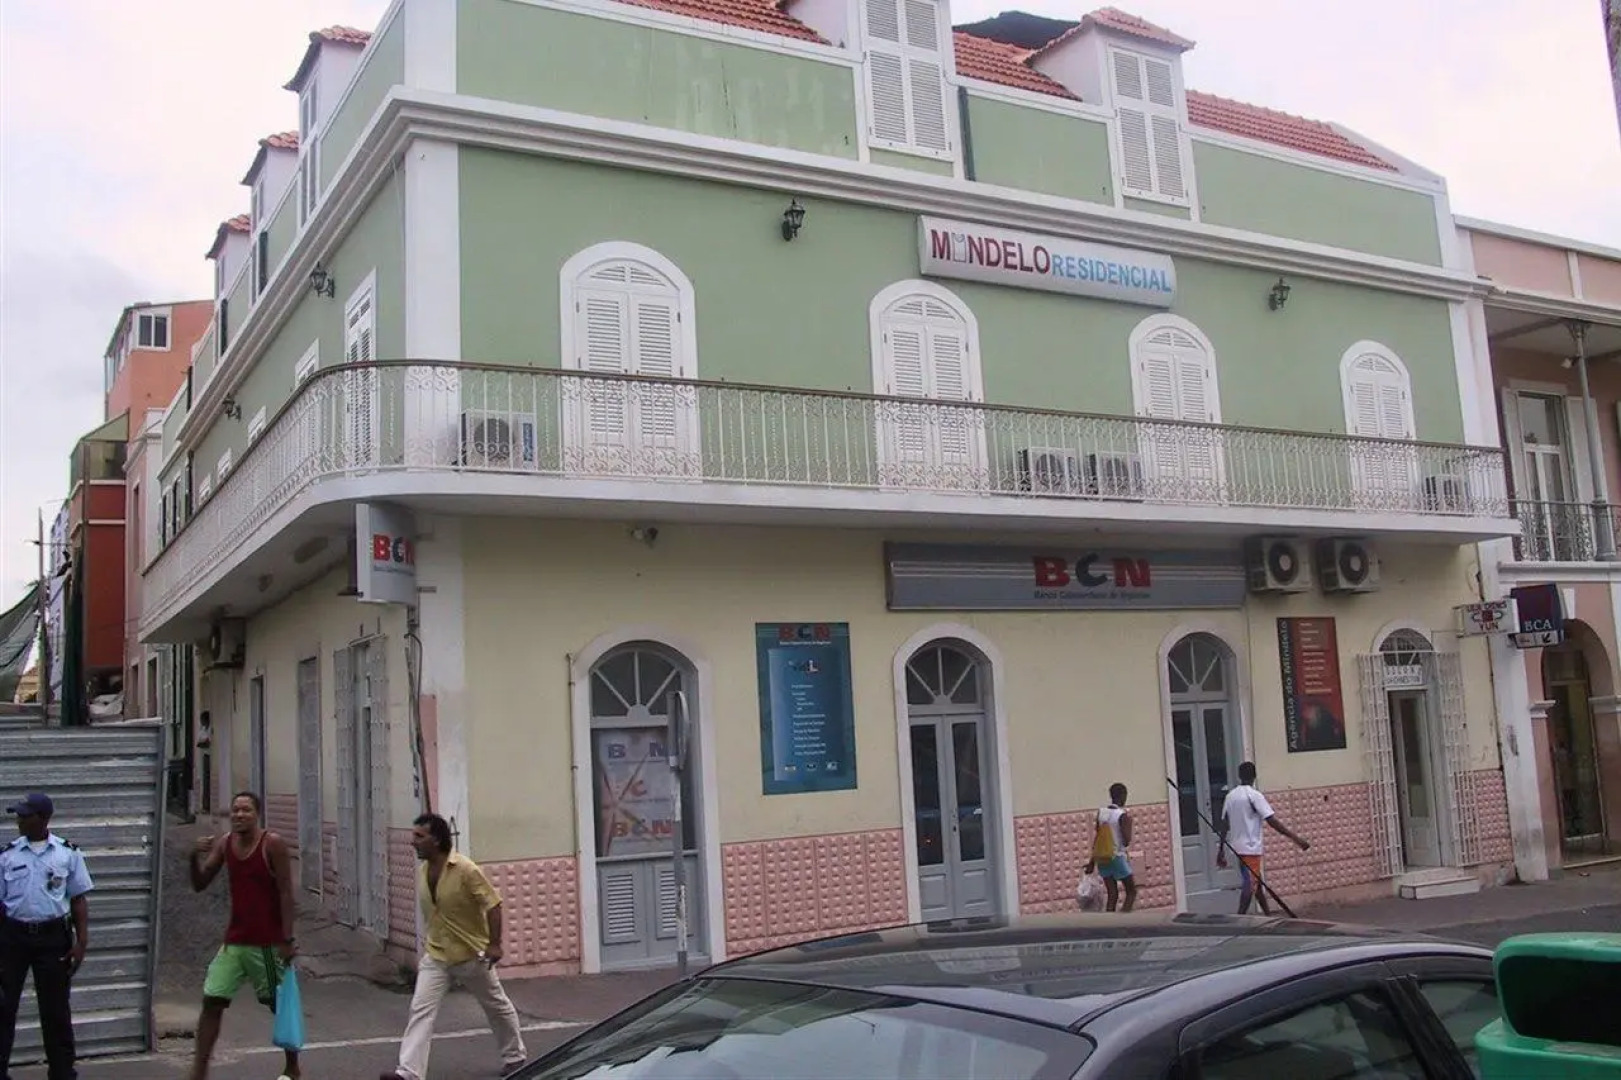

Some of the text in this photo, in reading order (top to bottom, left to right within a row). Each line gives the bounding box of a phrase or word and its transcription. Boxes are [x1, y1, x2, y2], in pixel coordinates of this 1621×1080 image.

[1052, 253, 1172, 292] RESIDENCIAL
[1032, 553, 1151, 587] BCN
[1524, 620, 1552, 633] BCA
